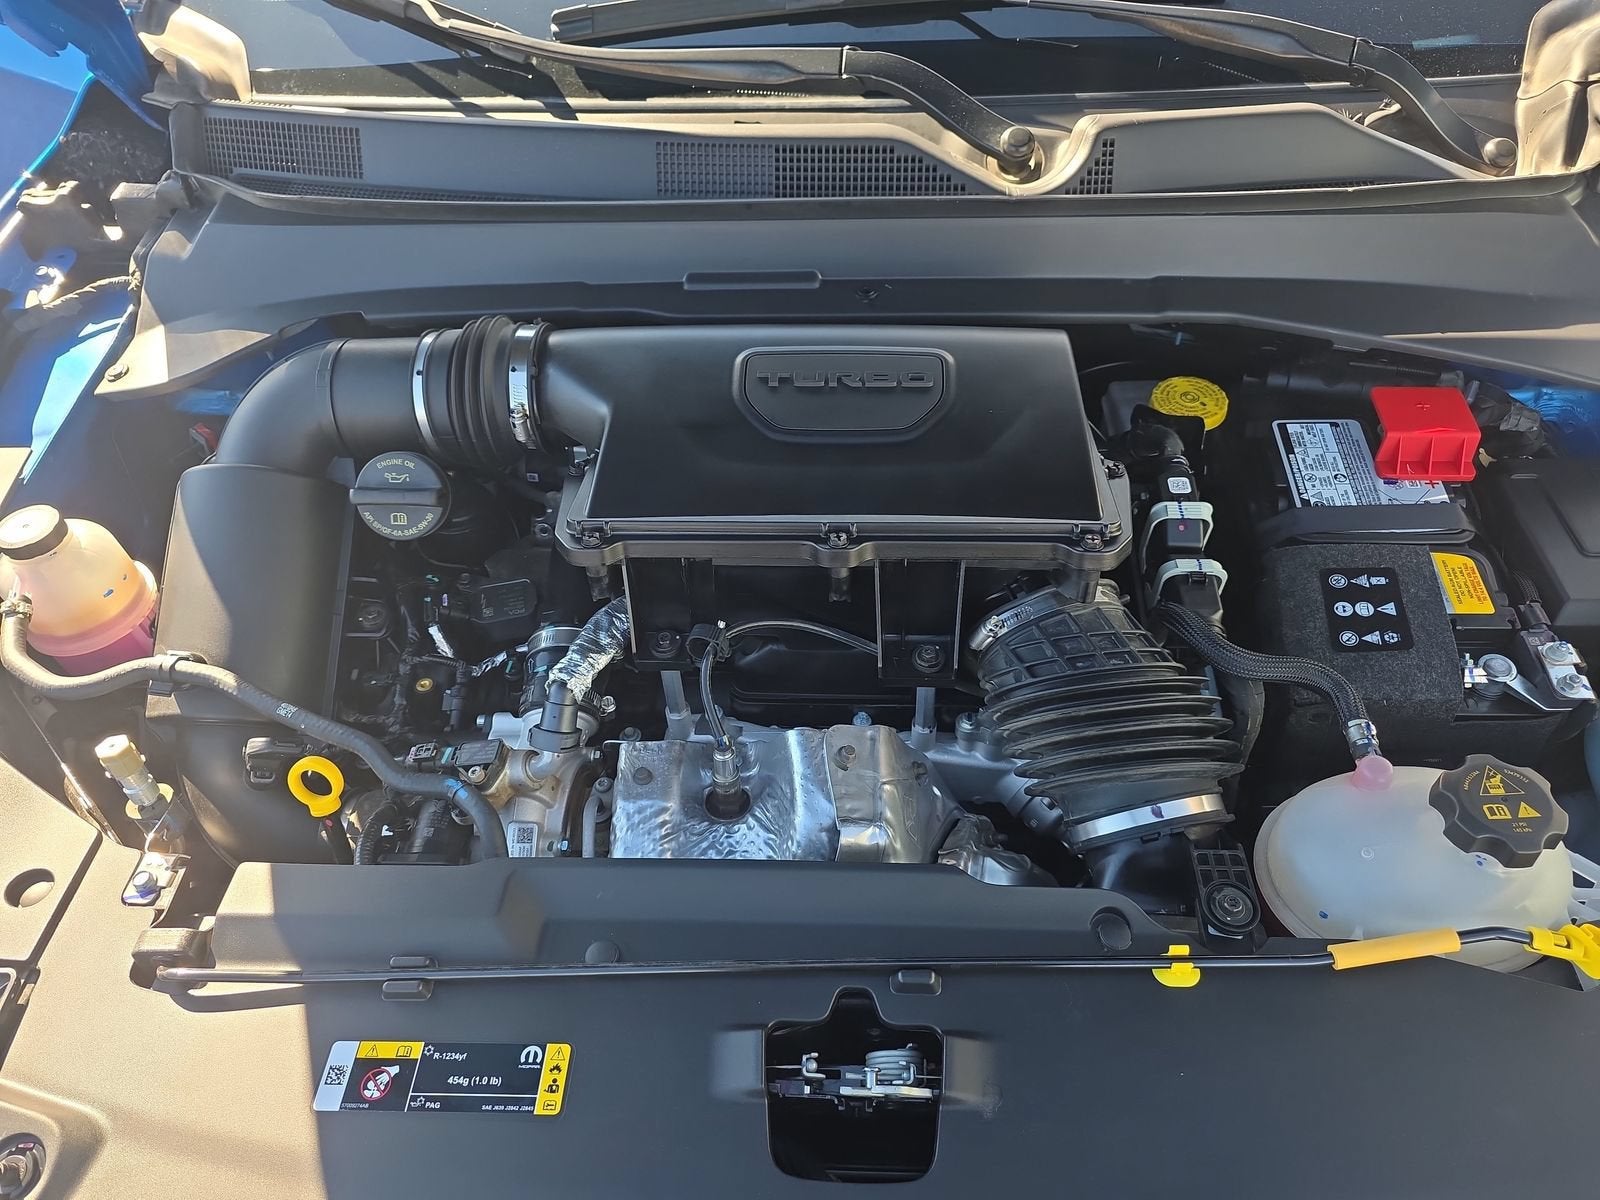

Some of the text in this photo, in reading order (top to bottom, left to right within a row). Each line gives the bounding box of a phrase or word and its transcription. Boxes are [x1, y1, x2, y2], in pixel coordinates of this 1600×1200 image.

[757, 370, 934, 388] TURBO
[376, 459, 416, 470] ENGINE OIL
[363, 511, 374, 522] API
[433, 1052, 467, 1061] R-1234yf
[447, 1076, 502, 1086] 454g (1.0 lb)
[425, 1101, 441, 1109] PAG
